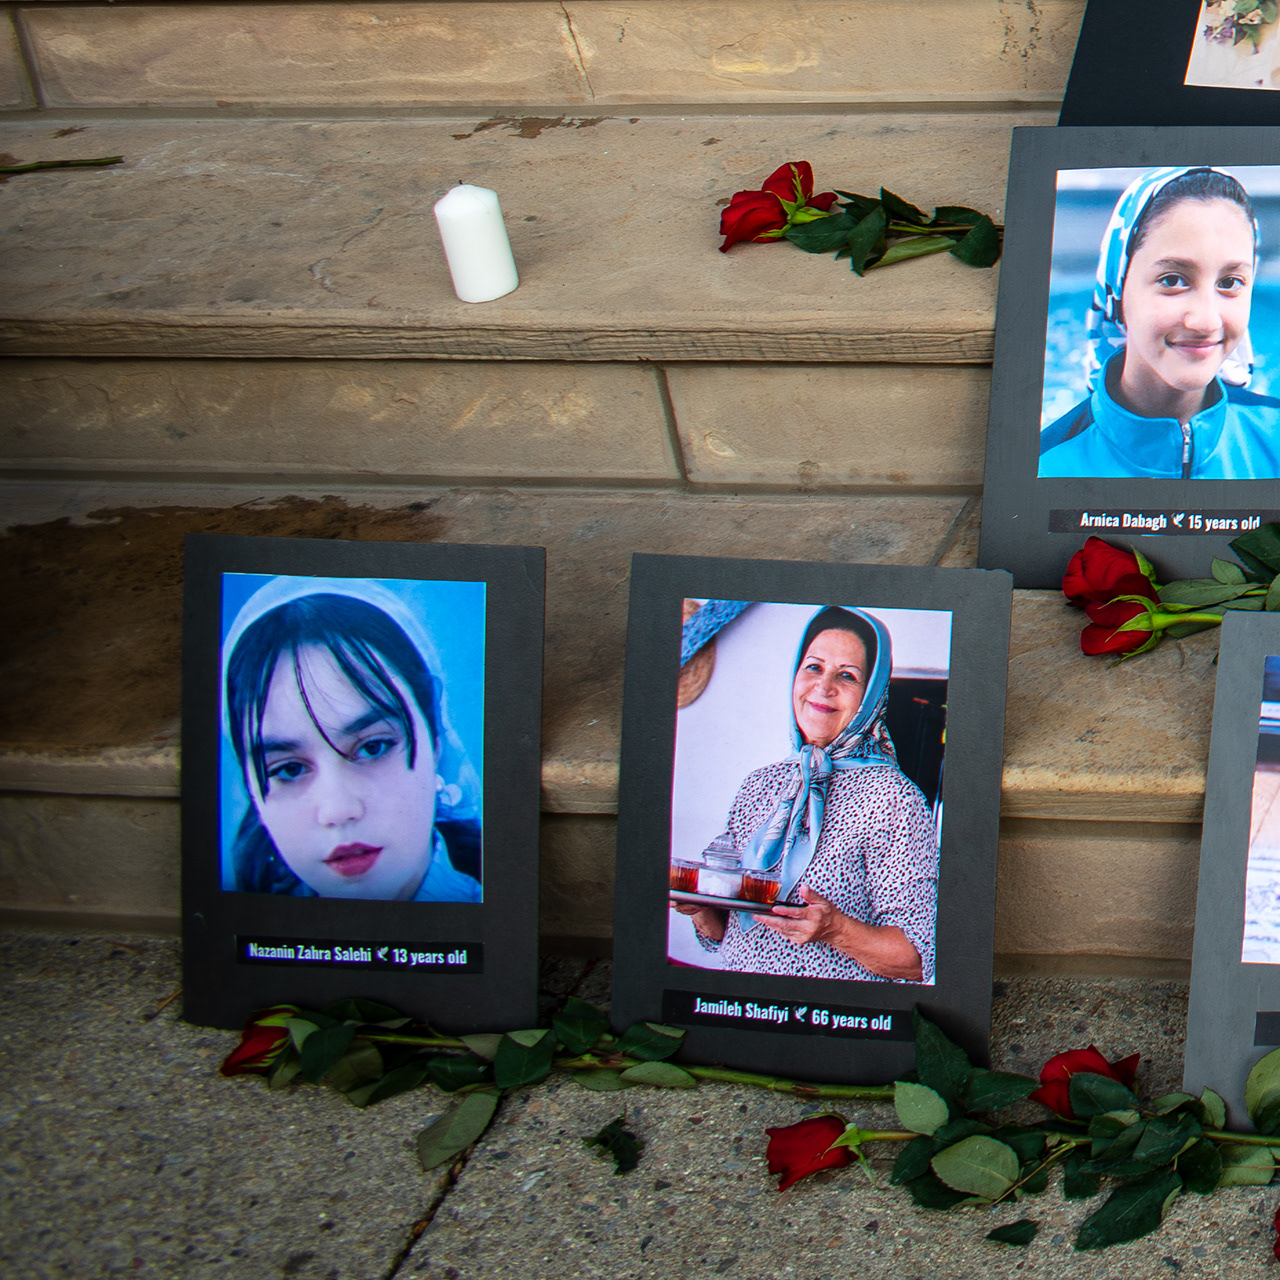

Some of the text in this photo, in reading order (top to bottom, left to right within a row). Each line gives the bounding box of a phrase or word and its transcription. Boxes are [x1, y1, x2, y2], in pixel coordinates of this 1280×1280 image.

[1080, 512, 1261, 532] Arnica Dabagh 15 years old
[248, 942, 468, 966] Nazanin Zahra Salehi 13 years old
[694, 997, 892, 1031] Jamileh Shafiyi 66 years old
